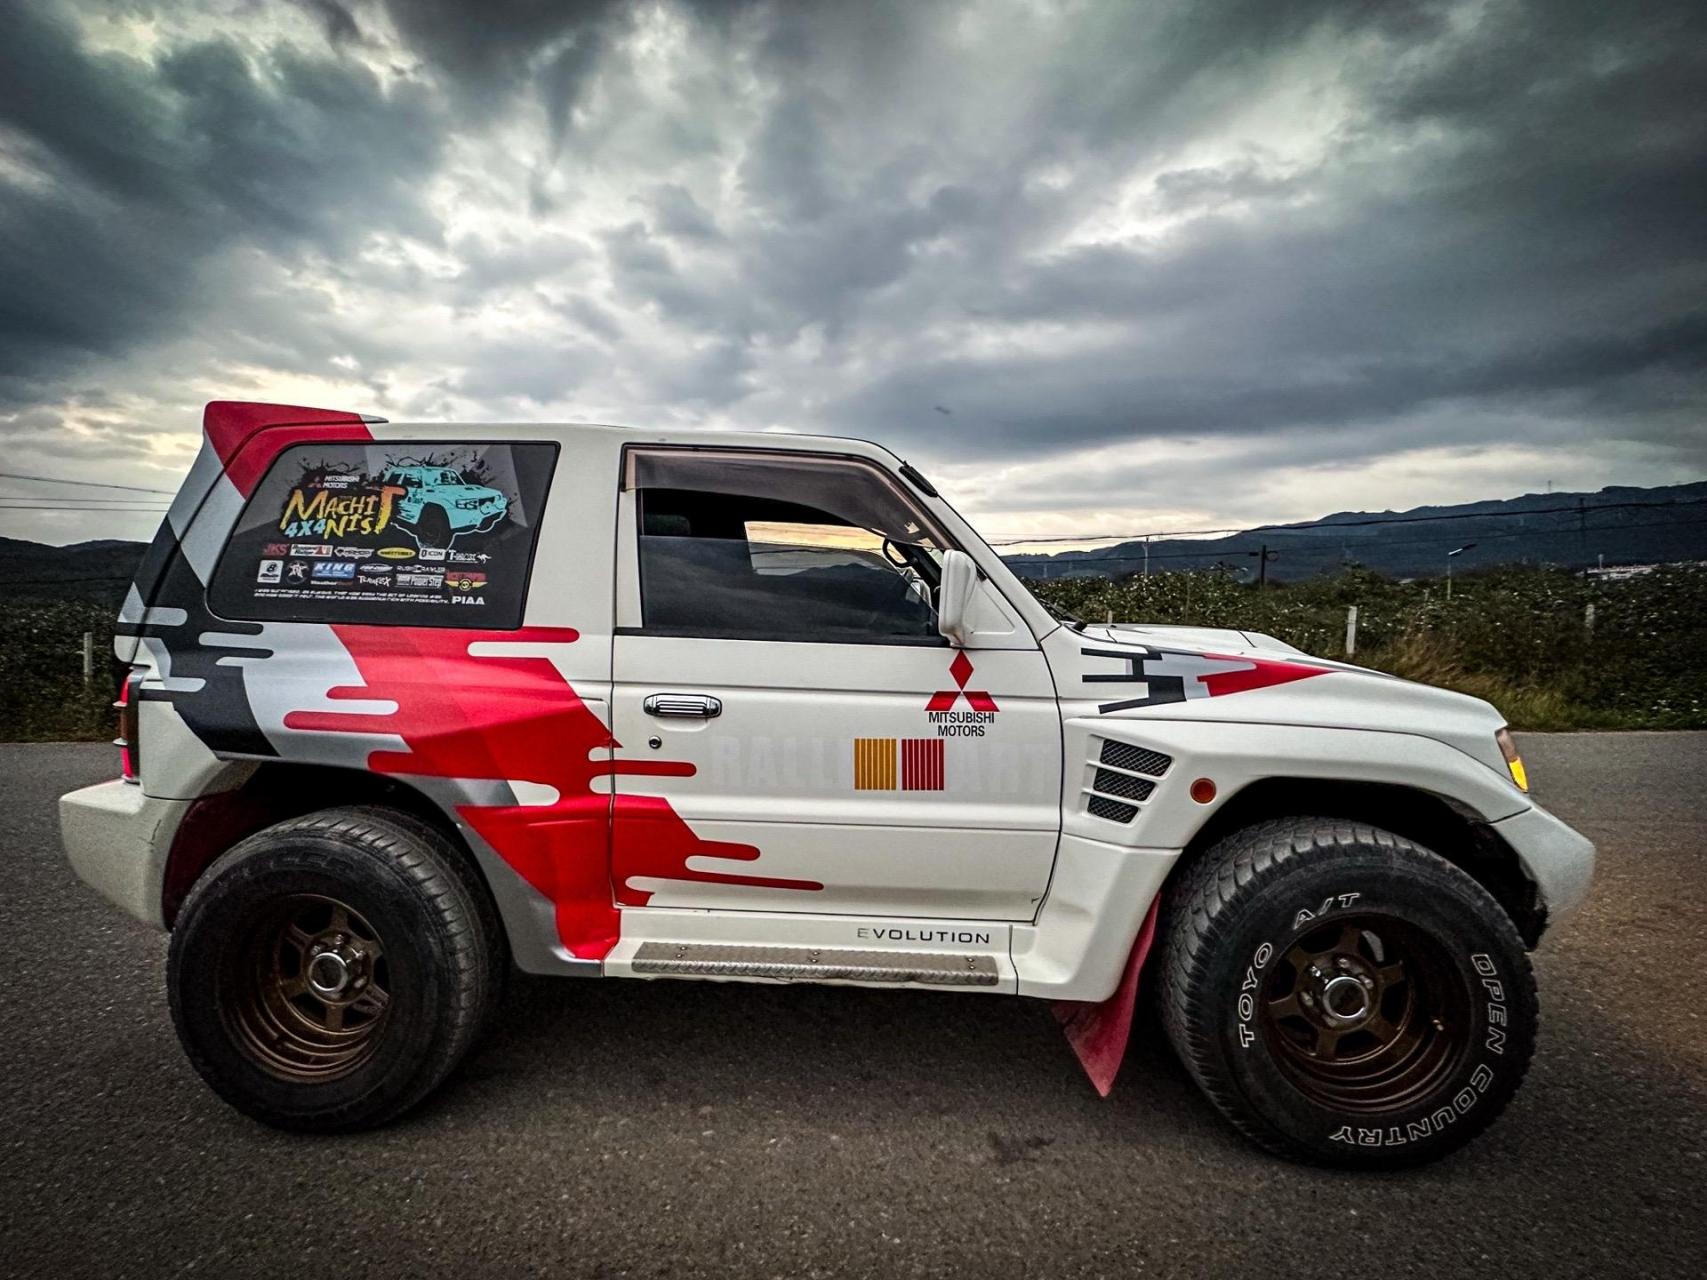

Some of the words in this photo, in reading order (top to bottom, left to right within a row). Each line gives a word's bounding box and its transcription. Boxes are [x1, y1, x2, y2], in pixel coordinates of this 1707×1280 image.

[265, 544, 289, 556] JKS
[315, 562, 353, 571] KING
[451, 596, 486, 605] PIAA
[928, 711, 995, 724] MITSUBISHI
[937, 724, 986, 737] MOTORS
[856, 927, 990, 944] EVOLUTION
[1238, 942, 1274, 1048] TOYO
[1293, 892, 1360, 930] A/T
[1472, 953, 1508, 1056] OPEN
[1329, 1063, 1495, 1147] COUNTRY
